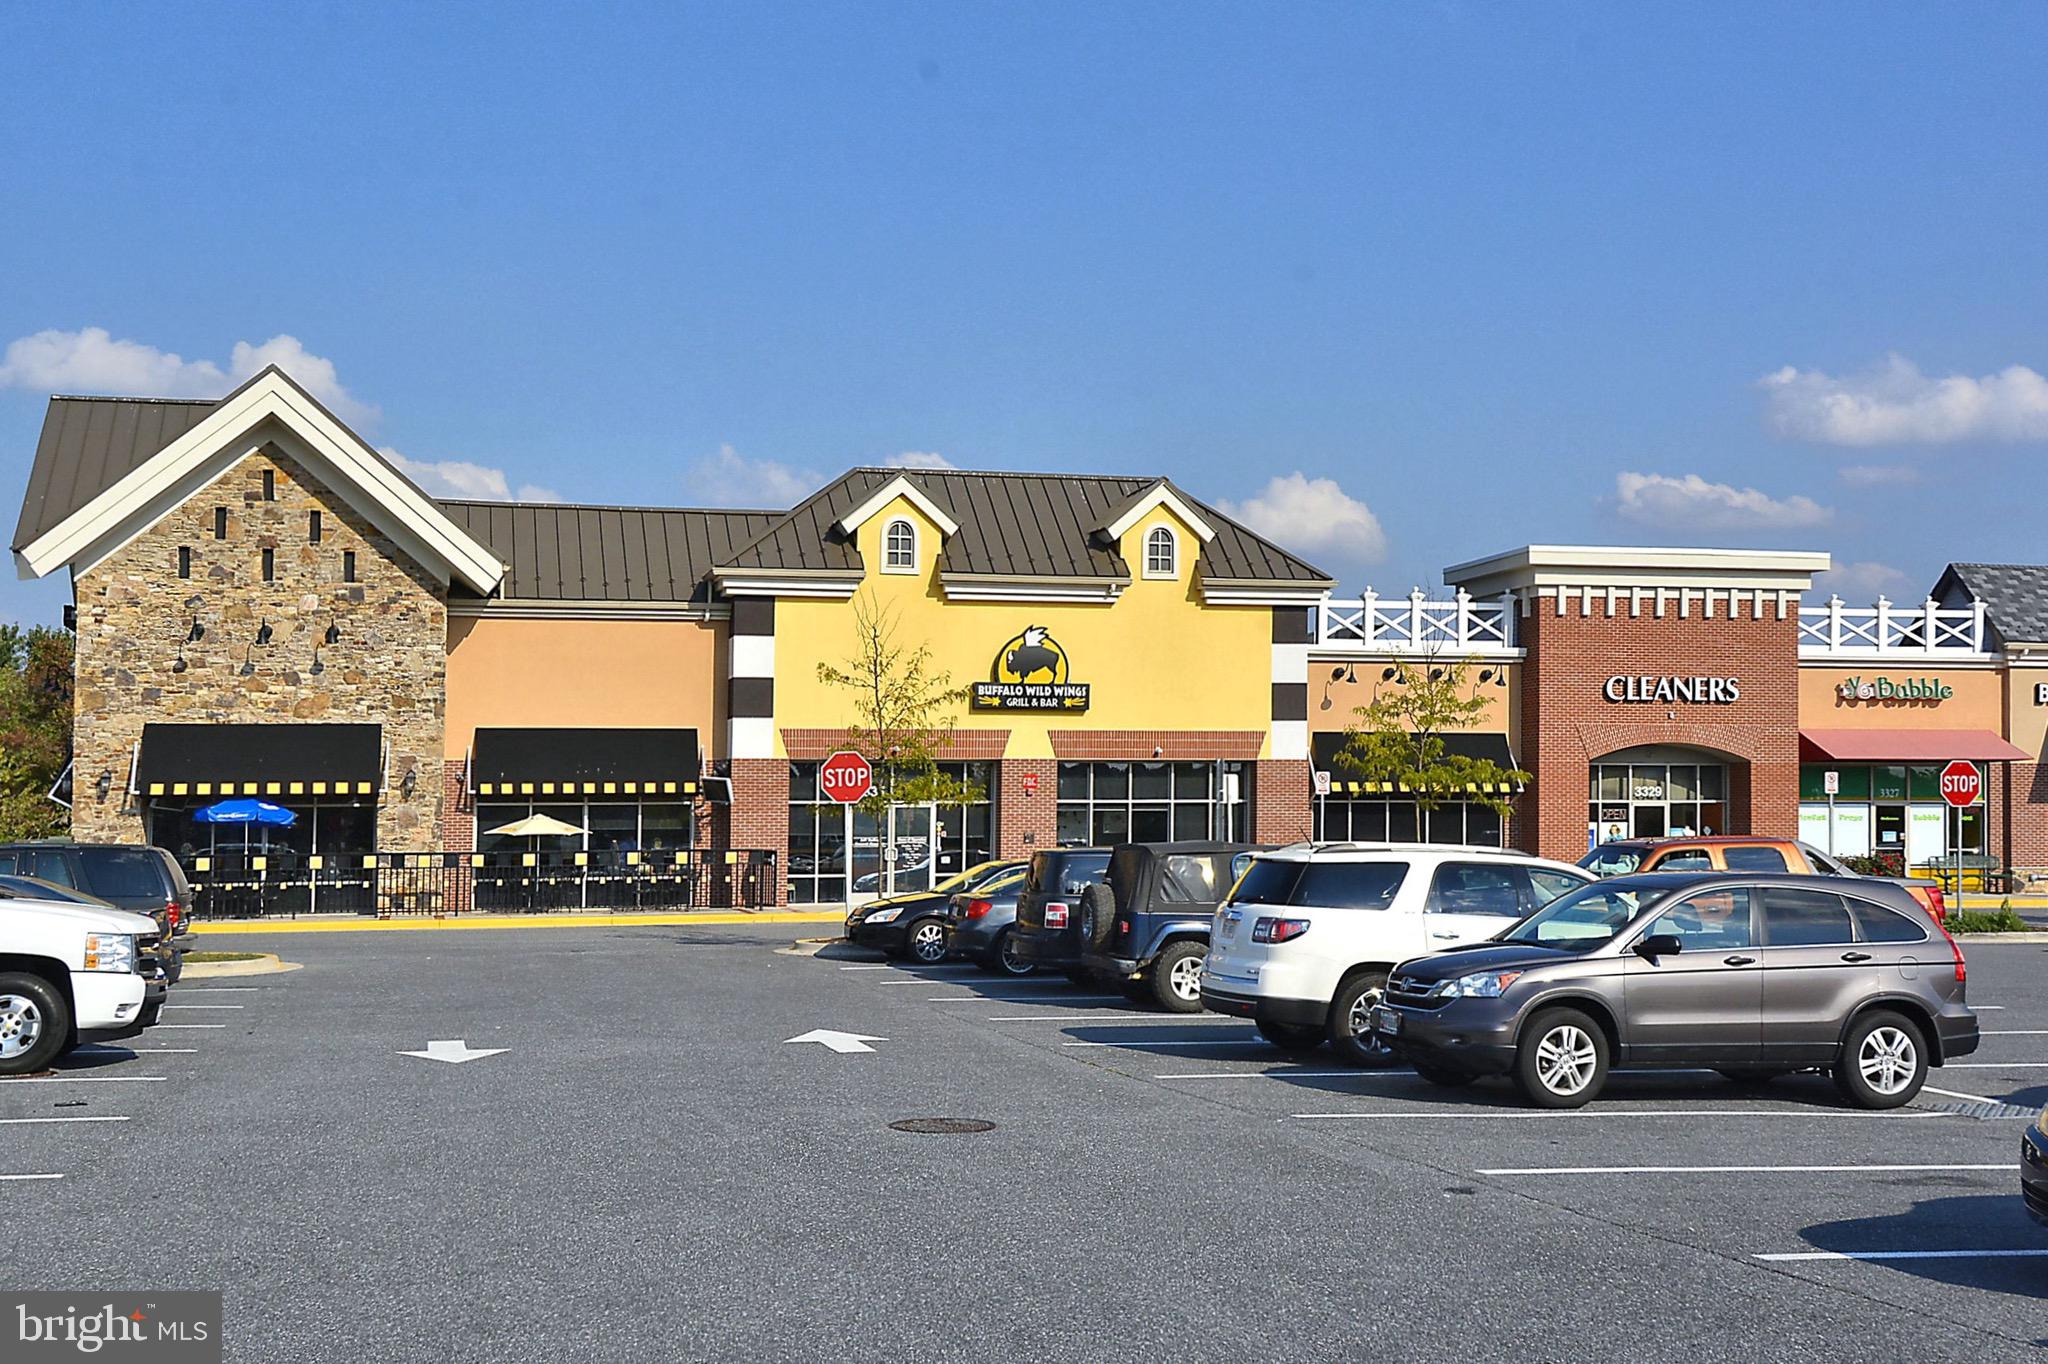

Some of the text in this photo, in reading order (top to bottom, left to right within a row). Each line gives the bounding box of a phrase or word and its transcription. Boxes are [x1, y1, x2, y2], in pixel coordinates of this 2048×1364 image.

[978, 685, 1087, 697] BUFFALO WILD WINGS
[1605, 675, 1740, 702] CLEANERS
[1006, 698, 1058, 707] GRILL & BAR
[825, 768, 868, 788] STOP
[1943, 775, 1978, 792] STOP
[1634, 786, 1663, 797] 3329
[1880, 788, 1900, 798] 3327
[1602, 808, 1627, 820] OPEN
